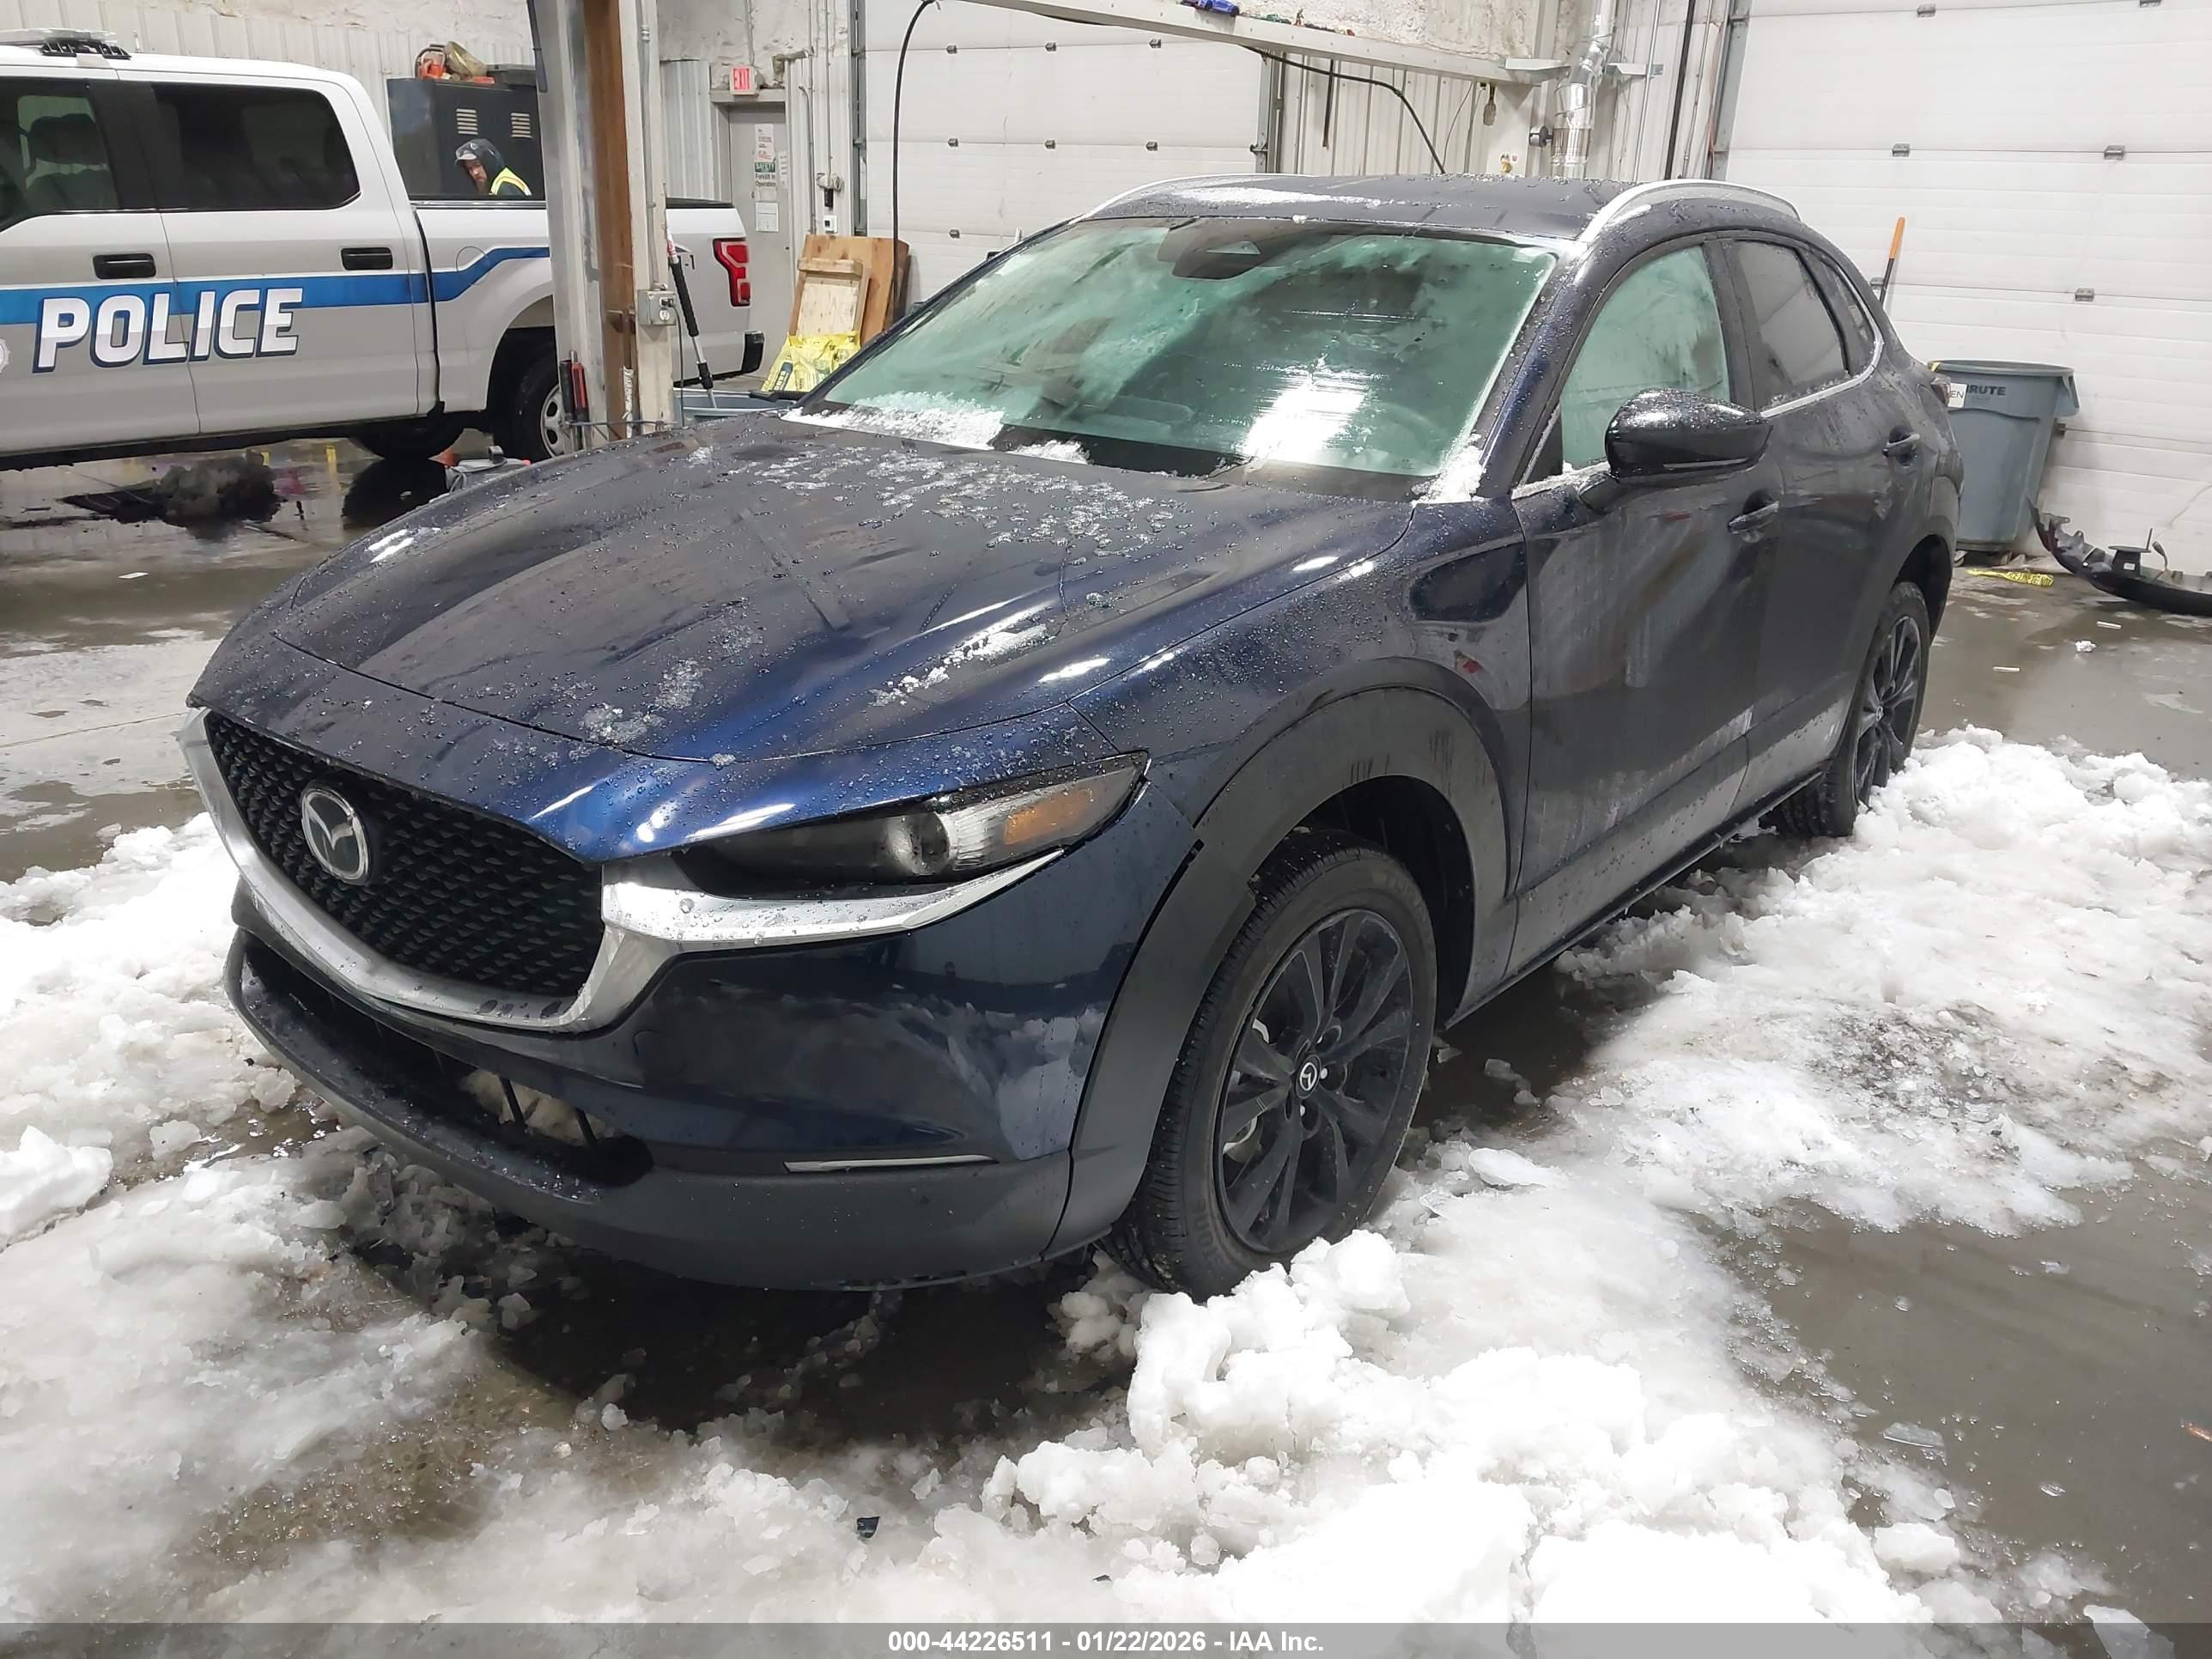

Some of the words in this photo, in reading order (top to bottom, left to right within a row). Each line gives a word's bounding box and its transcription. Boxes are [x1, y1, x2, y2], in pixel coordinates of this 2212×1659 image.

[732, 68, 750, 90] EXIT
[33, 287, 303, 373] POLICE
[1950, 390, 1965, 398] EN
